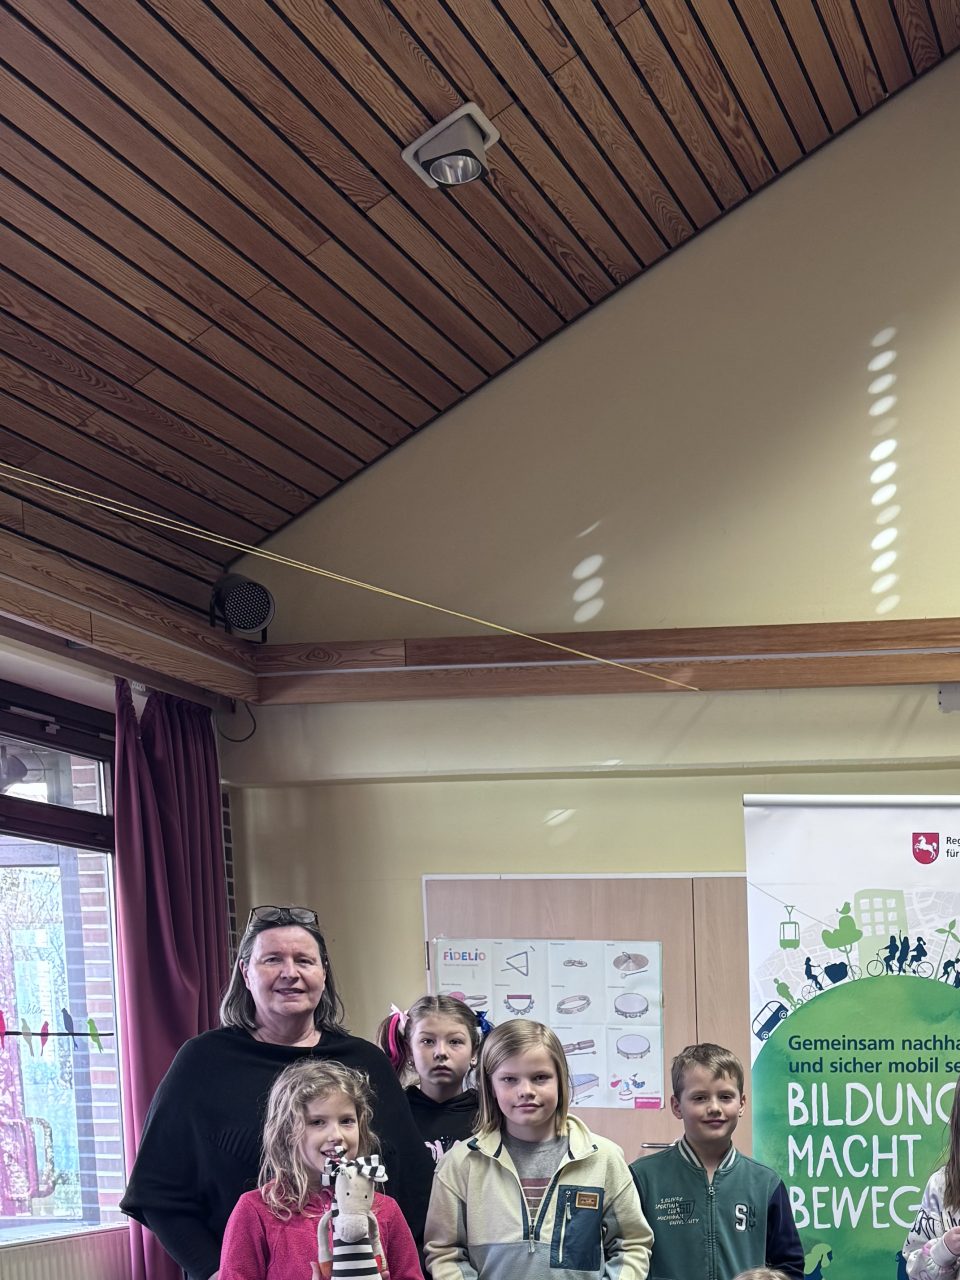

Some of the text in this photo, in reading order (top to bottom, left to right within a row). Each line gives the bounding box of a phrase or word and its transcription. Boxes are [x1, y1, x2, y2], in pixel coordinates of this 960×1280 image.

[946, 849, 959, 857] für
[788, 1035, 895, 1050] Gemeinsam
[789, 1057, 823, 1073] und
[830, 1057, 882, 1073] sicher
[889, 1057, 939, 1073] mobil
[787, 1134, 922, 1178] MACHT
[735, 1203, 748, 1232] S
[789, 1185, 924, 1229] BEWEG
